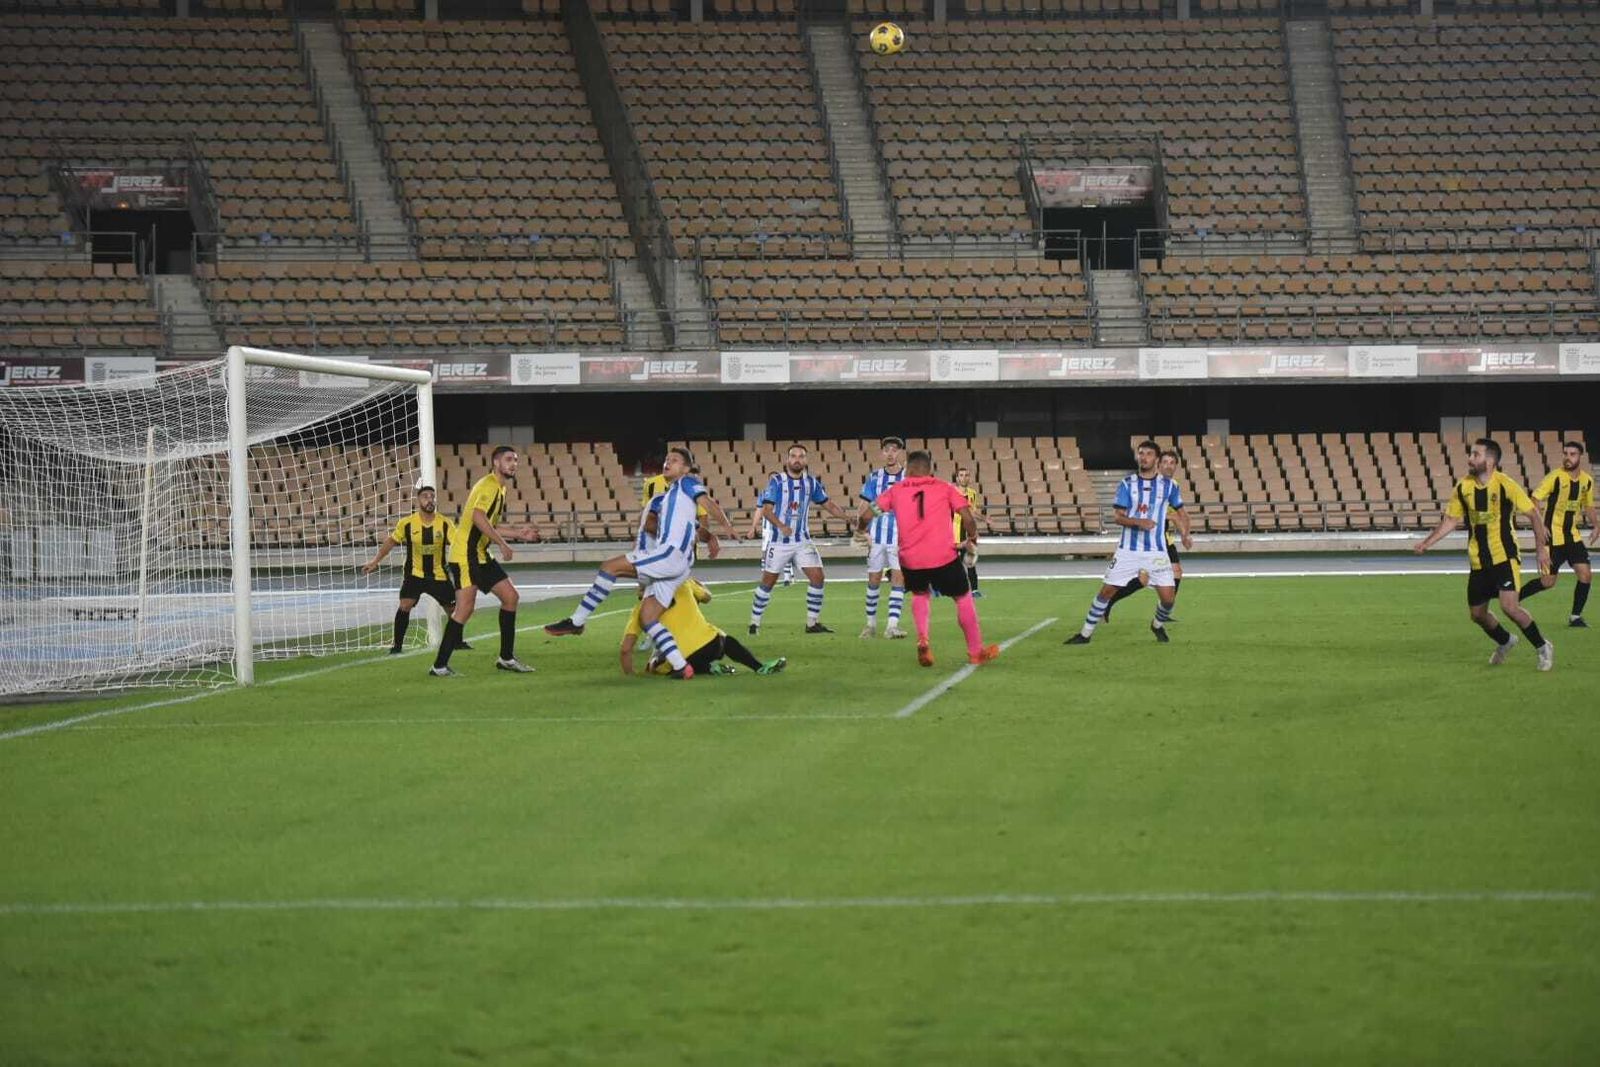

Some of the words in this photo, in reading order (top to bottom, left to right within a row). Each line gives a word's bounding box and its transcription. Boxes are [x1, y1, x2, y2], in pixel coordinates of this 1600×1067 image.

[101, 175, 164, 193] JEREZ
[1069, 175, 1130, 192] JEREZ
[588, 361, 641, 374] PLAY
[630, 360, 698, 381] JEREZ
[840, 359, 908, 379] JEREZ
[1048, 357, 1117, 377] JEREZ
[1257, 355, 1327, 374] JEREZ
[1467, 352, 1537, 372] JEREZ
[912, 491, 925, 519] 1
